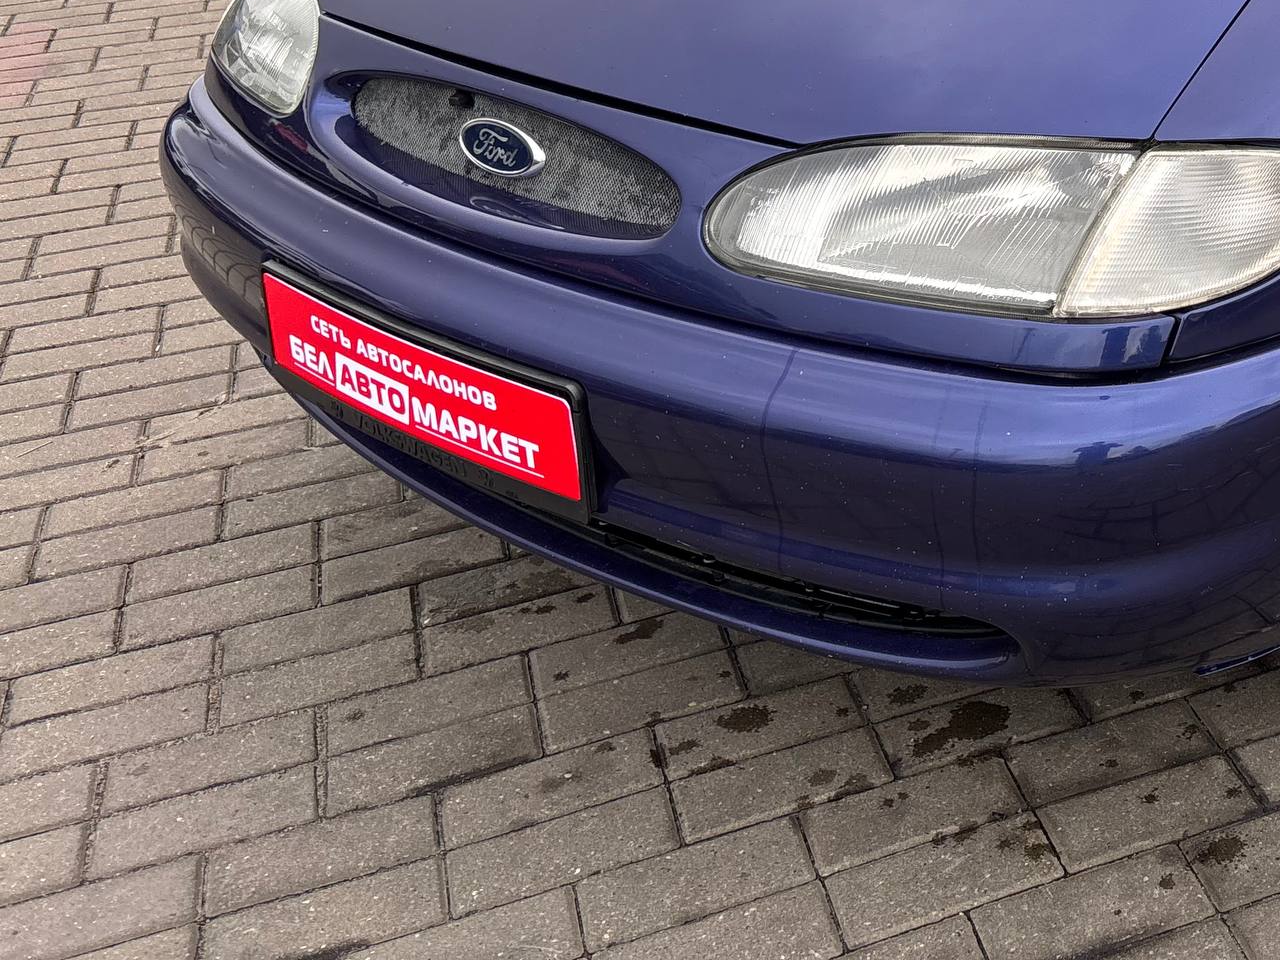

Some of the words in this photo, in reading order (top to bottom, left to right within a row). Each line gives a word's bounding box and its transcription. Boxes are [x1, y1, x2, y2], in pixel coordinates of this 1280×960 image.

[473, 128, 518, 167] Ford
[310, 314, 351, 349] СЕТЬ
[356, 338, 497, 411] АВТОСАЛОНОВ
